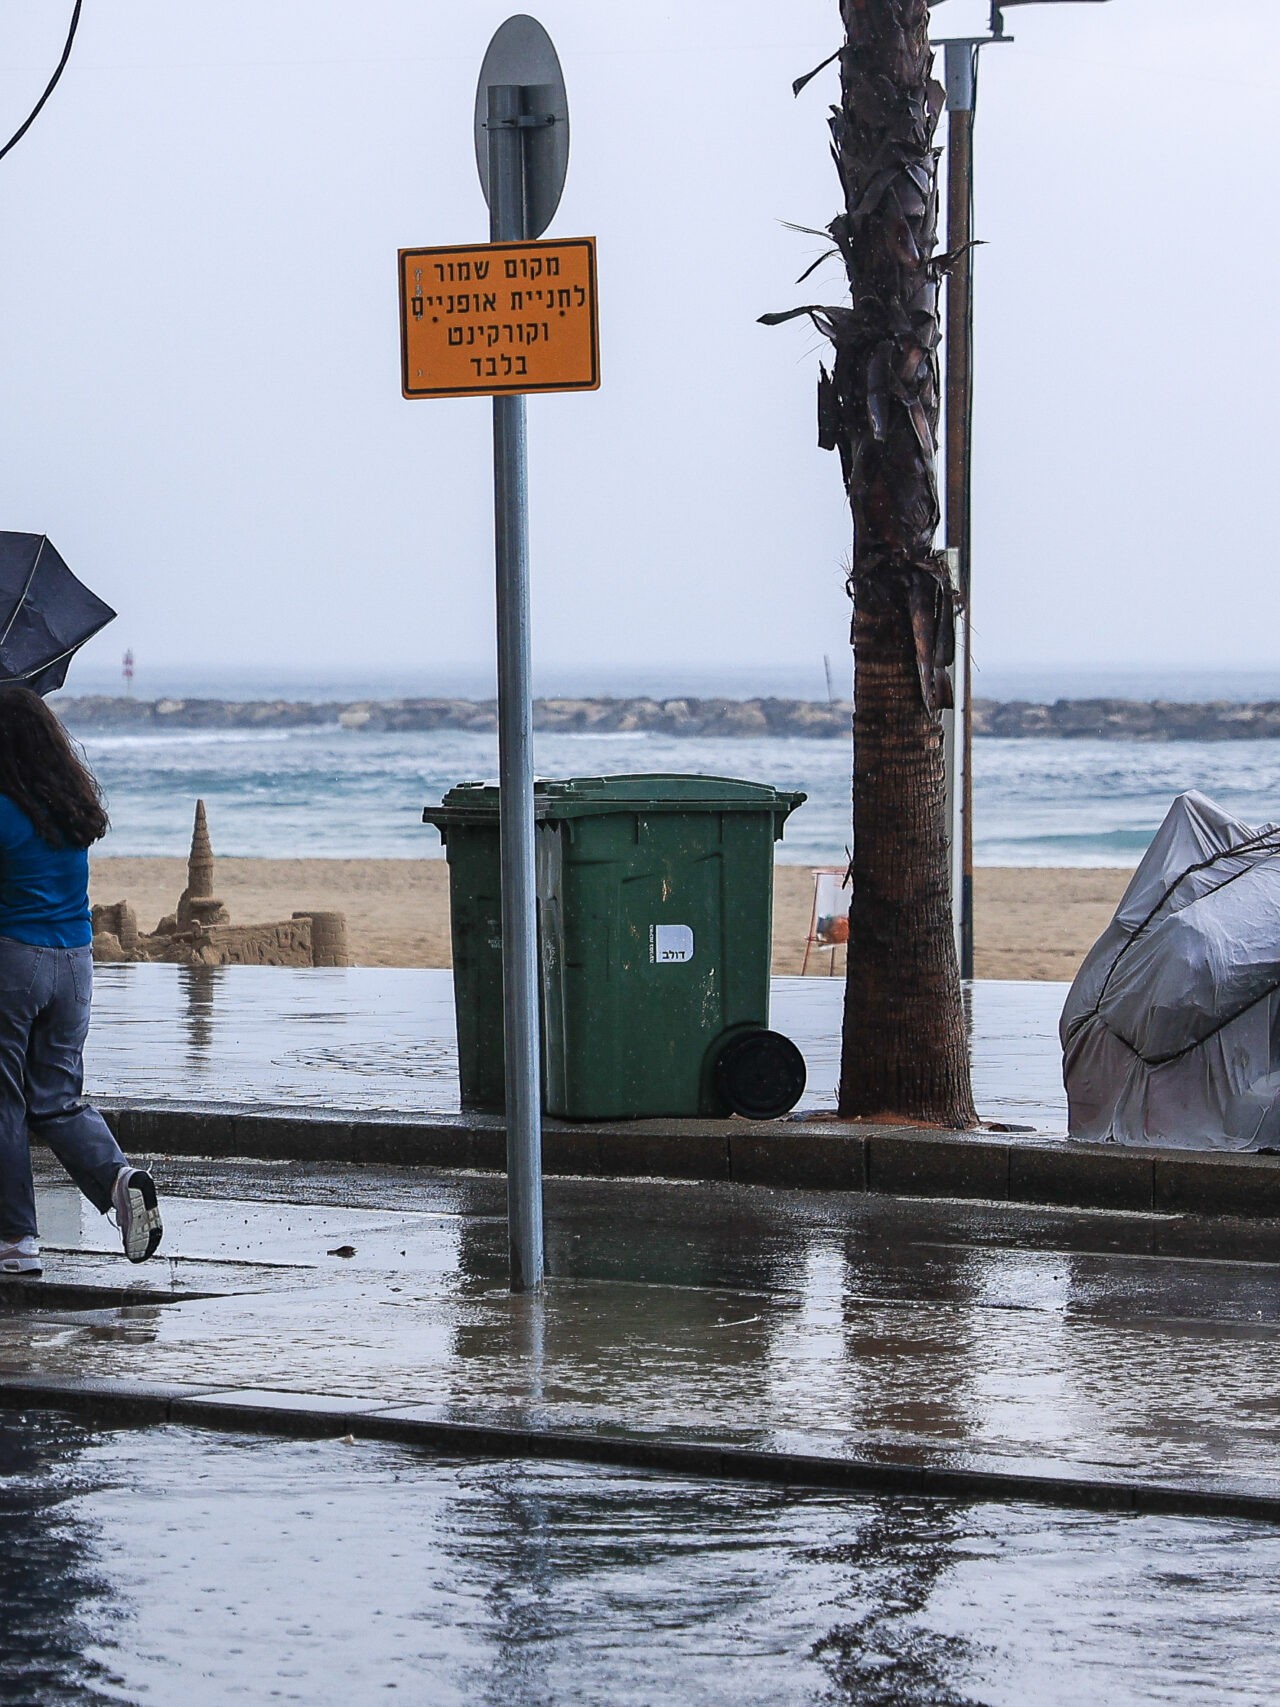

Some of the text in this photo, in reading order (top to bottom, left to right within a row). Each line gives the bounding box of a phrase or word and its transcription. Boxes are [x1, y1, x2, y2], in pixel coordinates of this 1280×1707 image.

[433, 256, 560, 282] מקום שמור
[410, 284, 586, 316] לחניית אופניים
[448, 322, 549, 347] וקורקינט
[470, 353, 528, 377] בלבד
[662, 949, 686, 960] דולב
